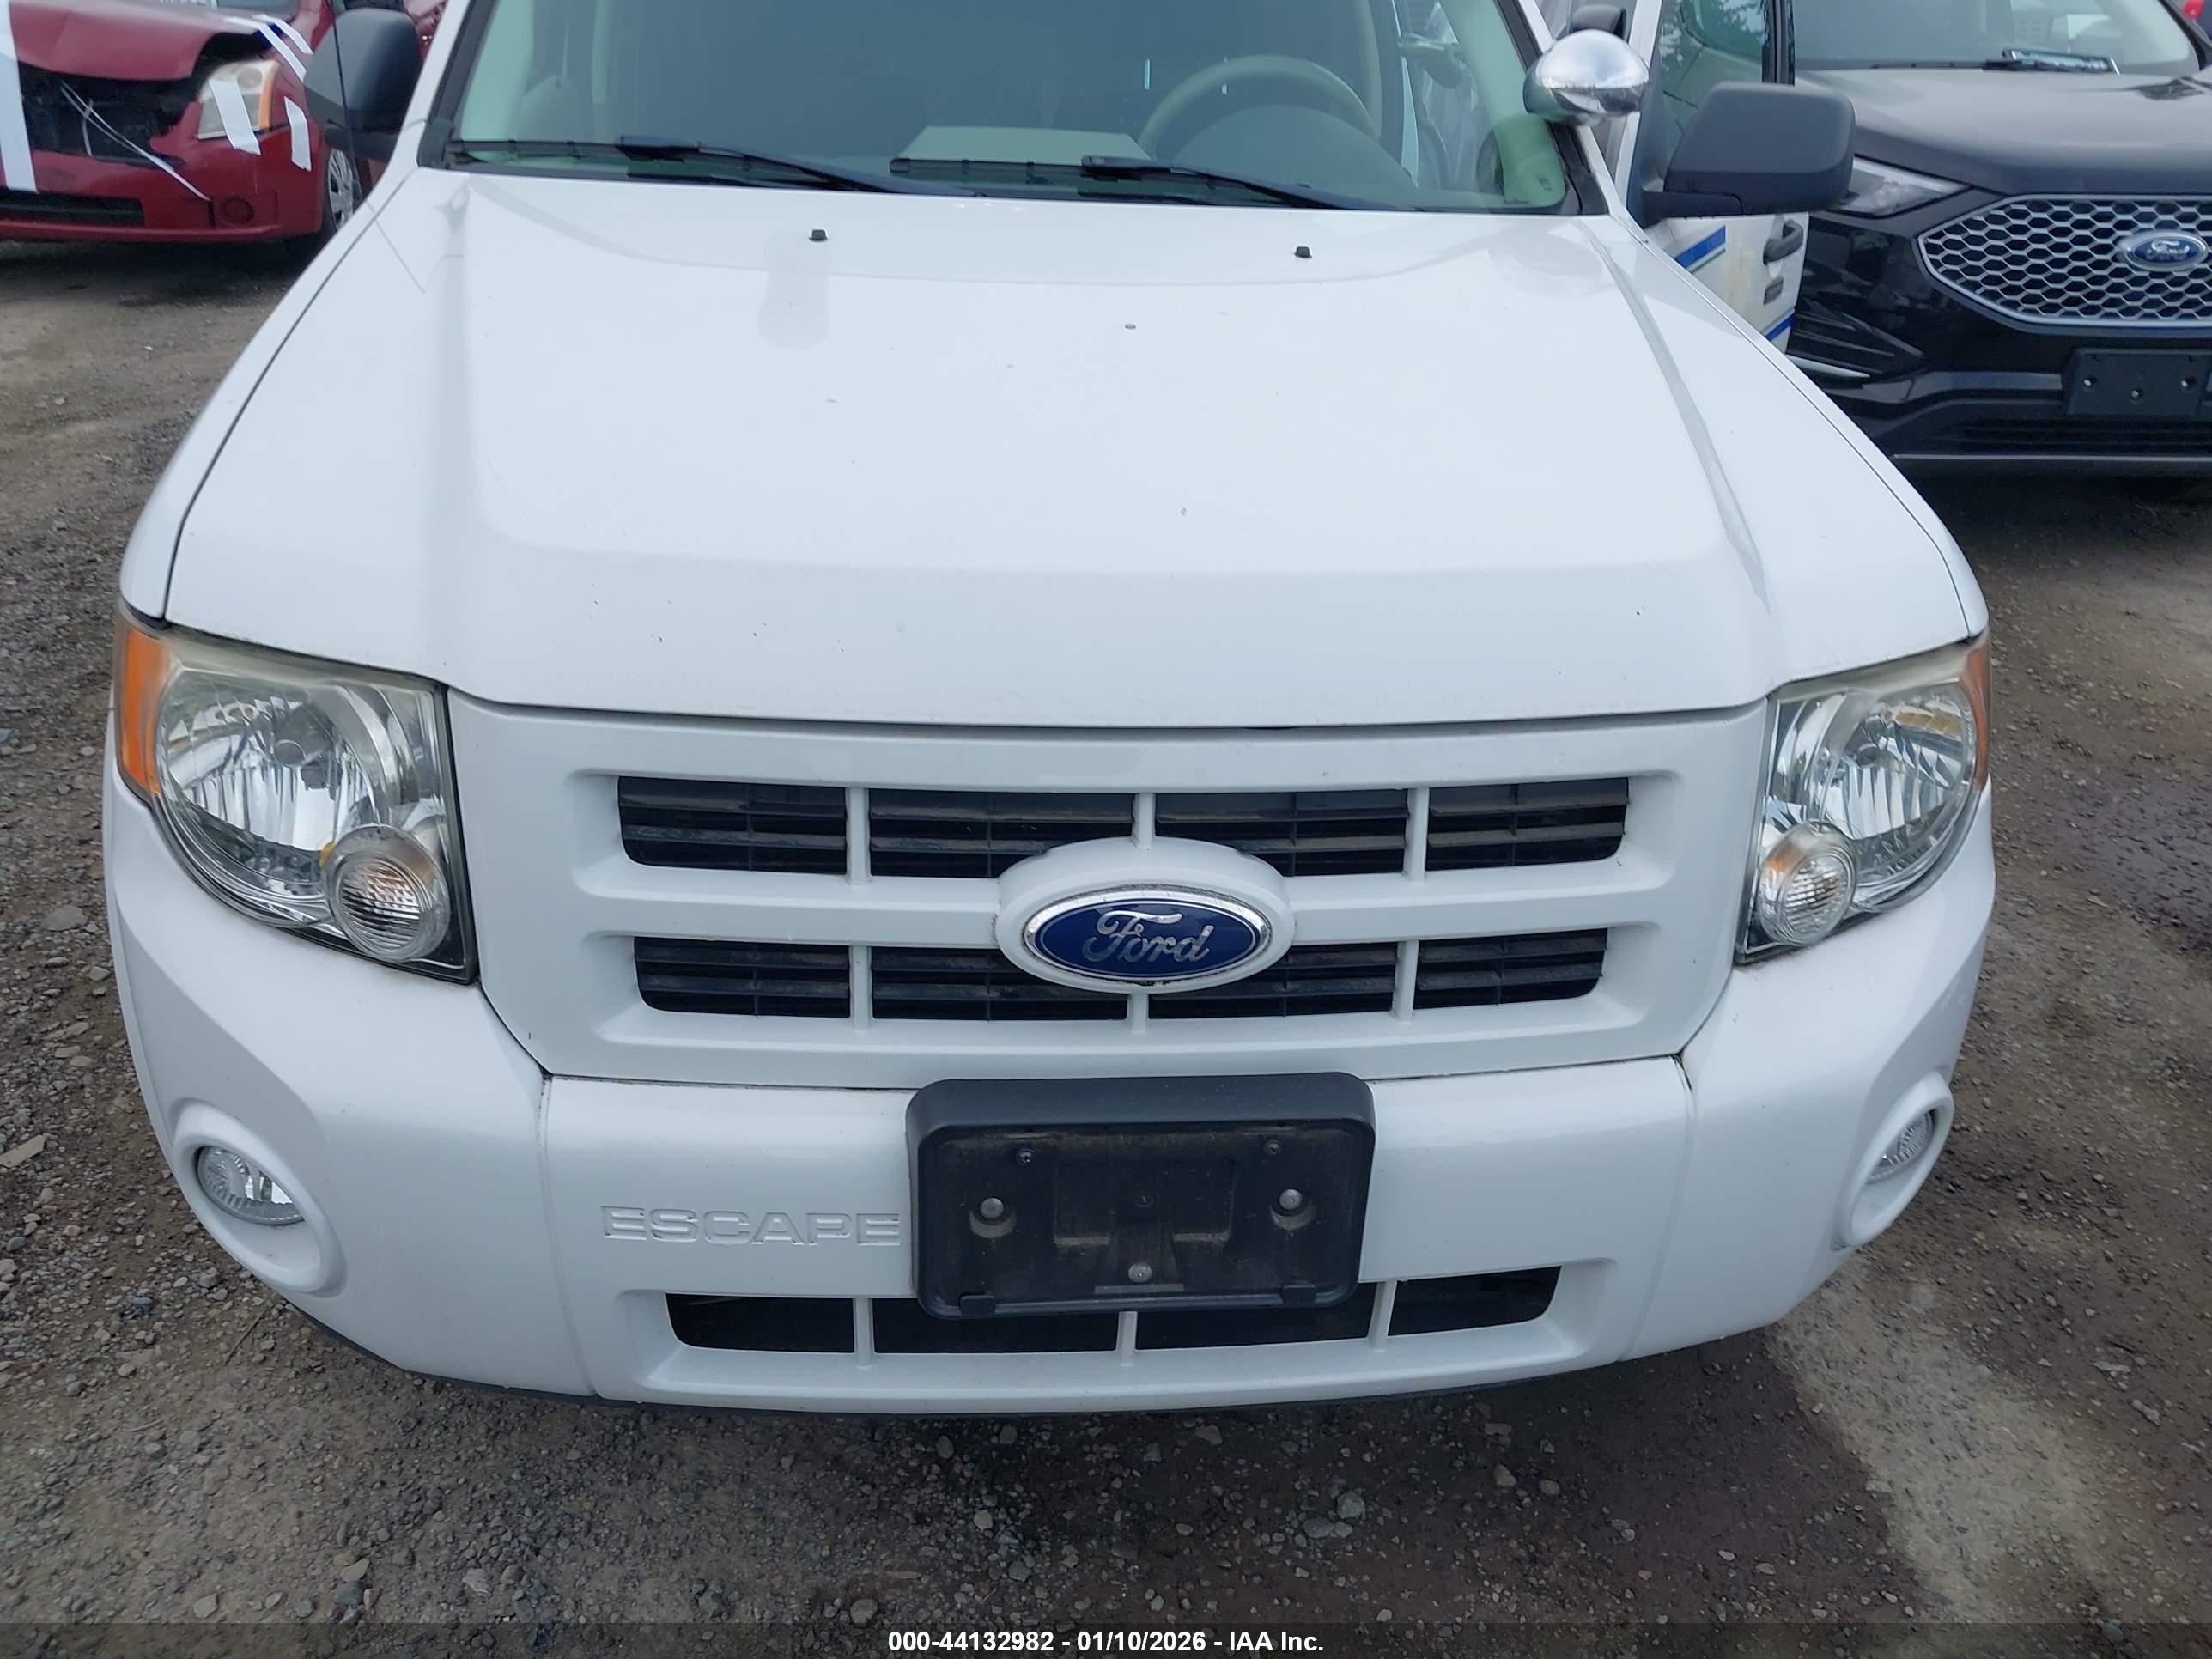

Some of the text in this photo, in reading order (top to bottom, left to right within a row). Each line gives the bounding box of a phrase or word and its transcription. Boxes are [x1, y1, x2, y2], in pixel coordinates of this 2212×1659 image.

[2146, 240, 2191, 260] Ford
[1082, 910, 1215, 963] Ford
[600, 1205, 901, 1246] ESCAPE
